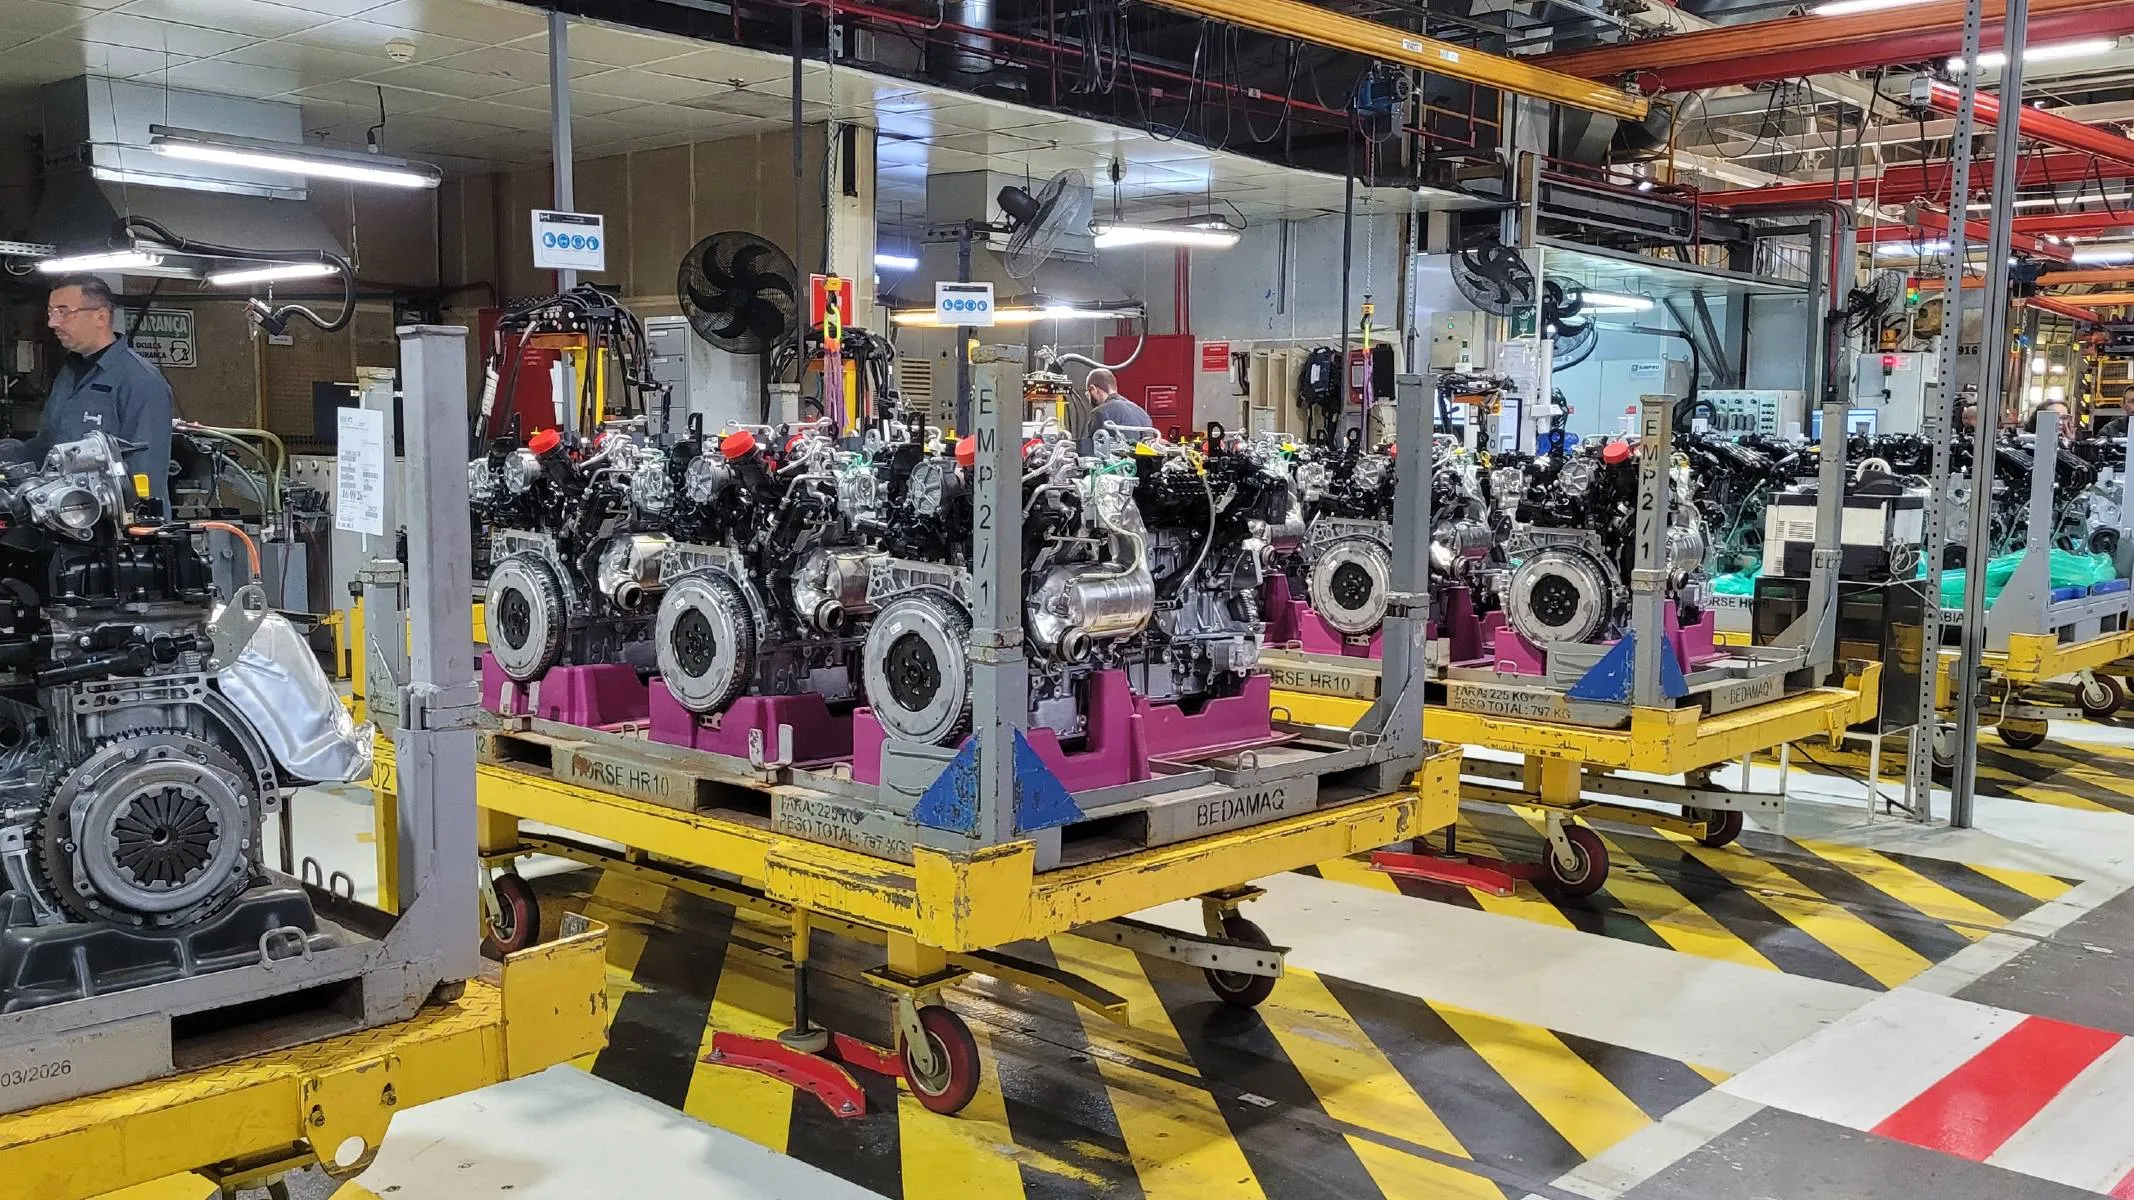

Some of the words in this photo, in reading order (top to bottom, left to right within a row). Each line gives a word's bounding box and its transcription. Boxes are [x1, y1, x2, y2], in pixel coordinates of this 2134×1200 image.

[126, 314, 188, 337] GURANÇA
[1706, 596, 1736, 608] RSE
[1310, 673, 1350, 692] HR10
[1490, 688, 1509, 700] 225
[1512, 691, 1528, 702] KG
[1488, 700, 1528, 716] TOTAL:
[1531, 705, 1550, 717] 797
[1554, 708, 1571, 719] KG
[629, 769, 670, 797] HR10
[817, 802, 839, 821] 225
[1197, 788, 1285, 827] BEDAMAQ
[779, 812, 813, 833] PESO
[815, 820, 859, 846] TOTAL:
[0, 1060, 72, 1087] 03/2026
